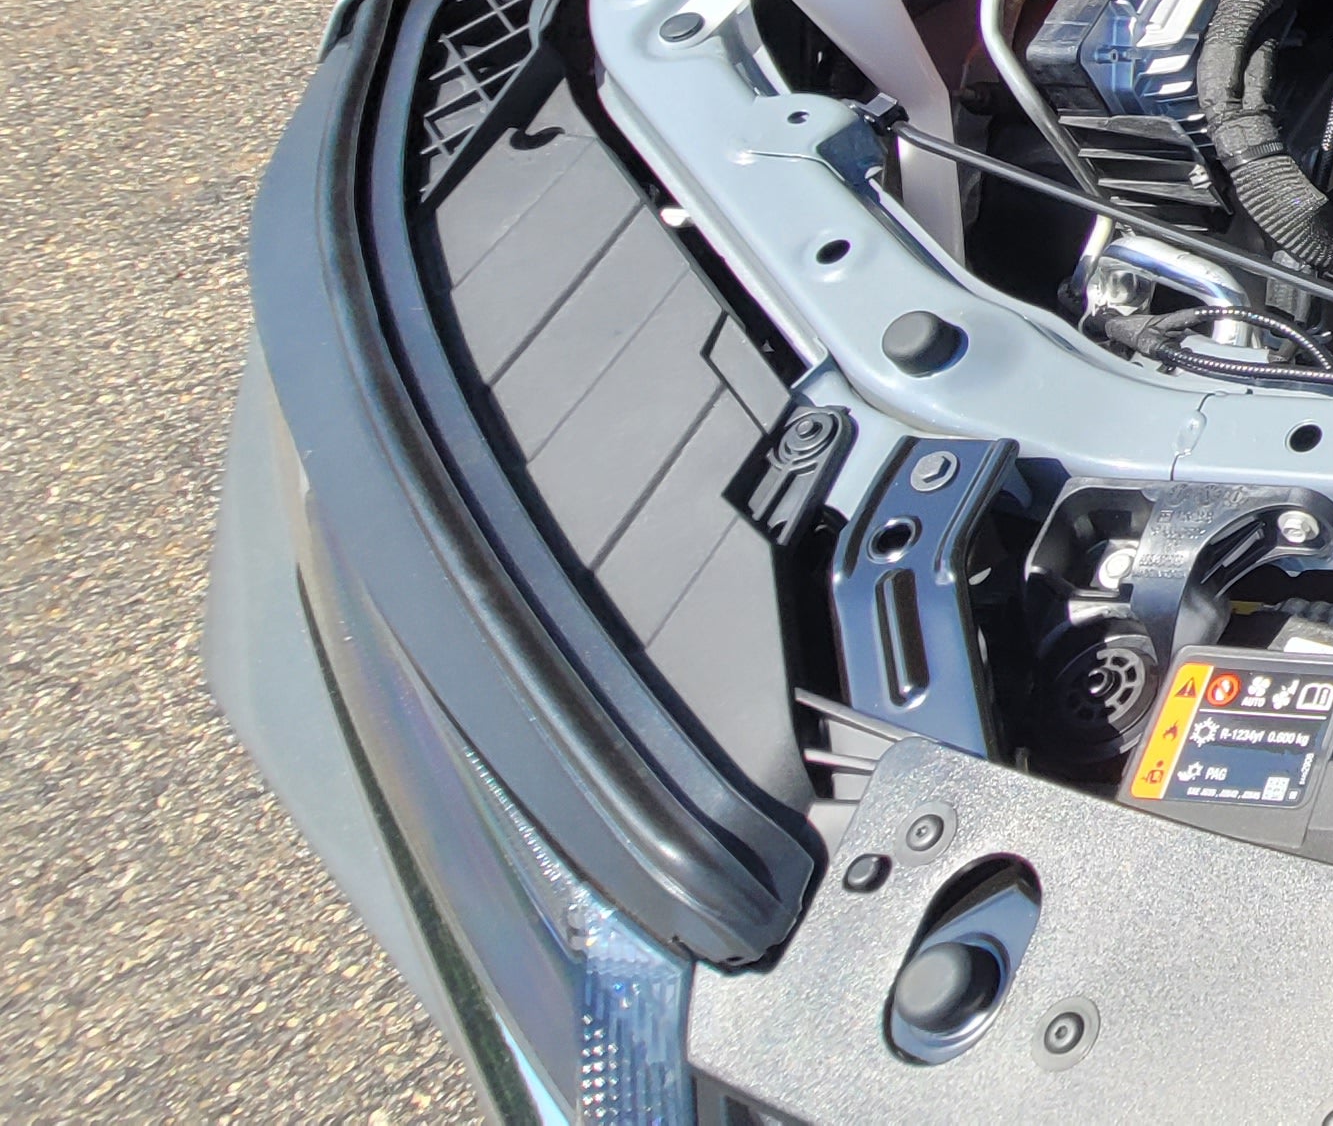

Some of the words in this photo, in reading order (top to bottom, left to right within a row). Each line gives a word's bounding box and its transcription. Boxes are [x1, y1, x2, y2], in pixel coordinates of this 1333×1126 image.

[1241, 696, 1266, 708] AUTO
[1219, 728, 1265, 744] R-1234yf
[1295, 732, 1310, 747] kg
[1204, 766, 1228, 781] PAG
